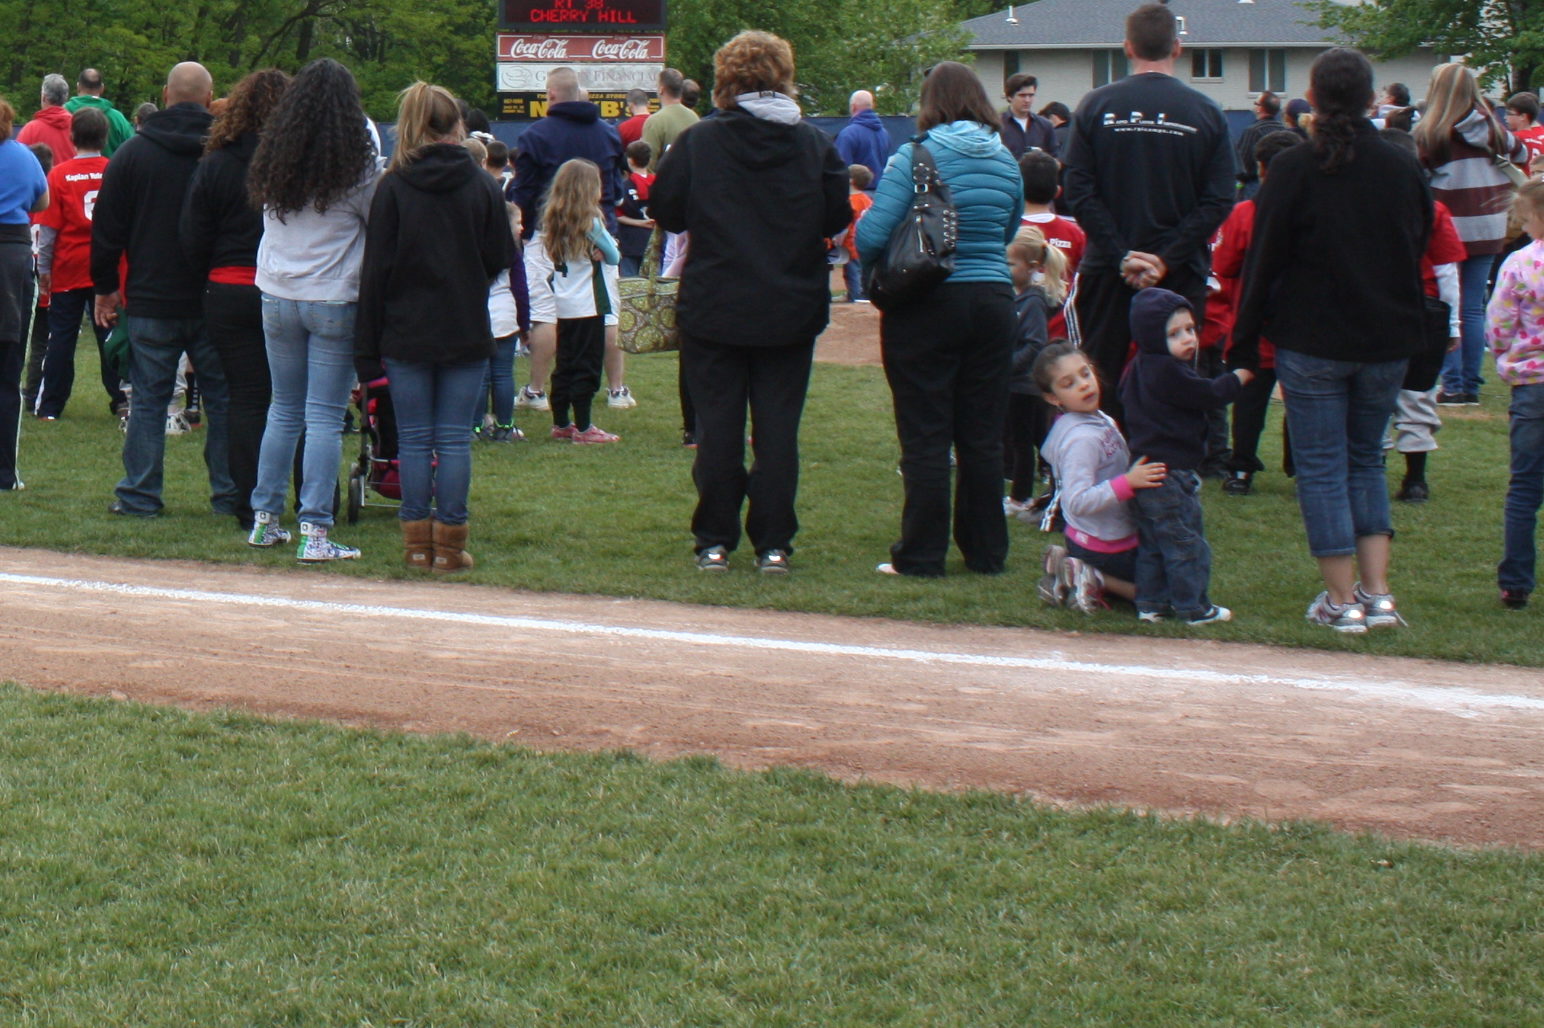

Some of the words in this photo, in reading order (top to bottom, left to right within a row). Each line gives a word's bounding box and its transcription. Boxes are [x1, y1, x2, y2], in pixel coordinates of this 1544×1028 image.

[530, 9, 589, 22] CHERRY
[598, 10, 637, 23] HILL
[511, 38, 569, 59] Coca-Cola
[592, 39, 650, 59] Coca-Cola
